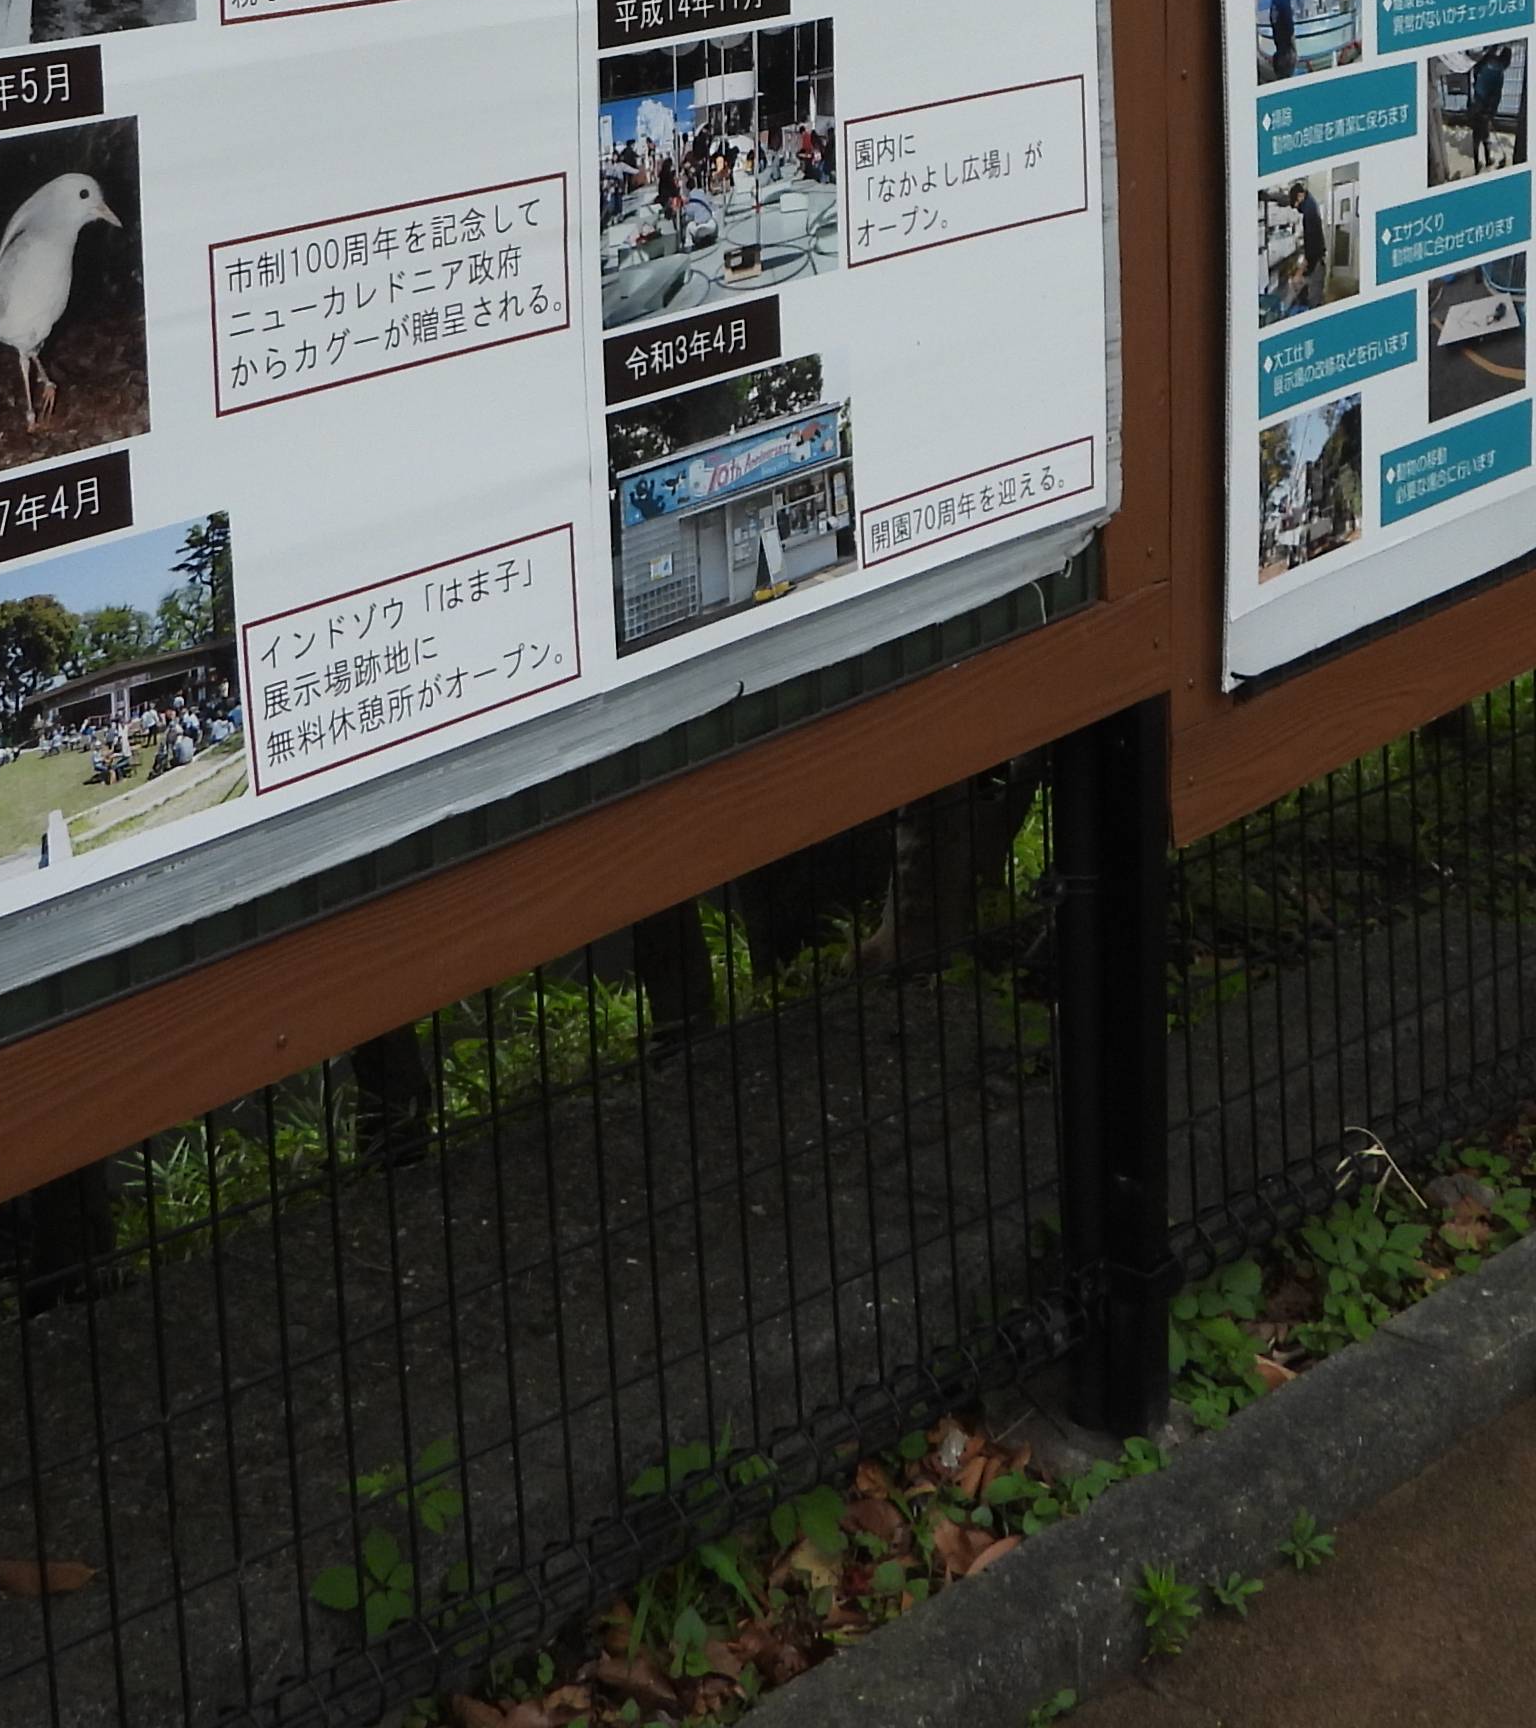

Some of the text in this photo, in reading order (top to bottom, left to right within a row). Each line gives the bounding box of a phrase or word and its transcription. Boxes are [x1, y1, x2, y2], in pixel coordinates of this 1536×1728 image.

[854, 133, 918, 171] 園内に
[864, 141, 1044, 203] 「なかよし広場」が
[225, 197, 542, 294] 市制100周年を記念して
[856, 206, 950, 248] オープン。
[228, 242, 524, 339] ニューカレドニア政府
[229, 282, 563, 391] からカグーが贈呈される。
[625, 319, 747, 382] 令和3年4月
[870, 464, 1066, 553] 開園70周年を迎える。
[259, 558, 534, 664] インドゾウ「はま子」
[262, 634, 439, 720] 展示場跡地に
[266, 644, 564, 767] 無料休憩所がオープン。
